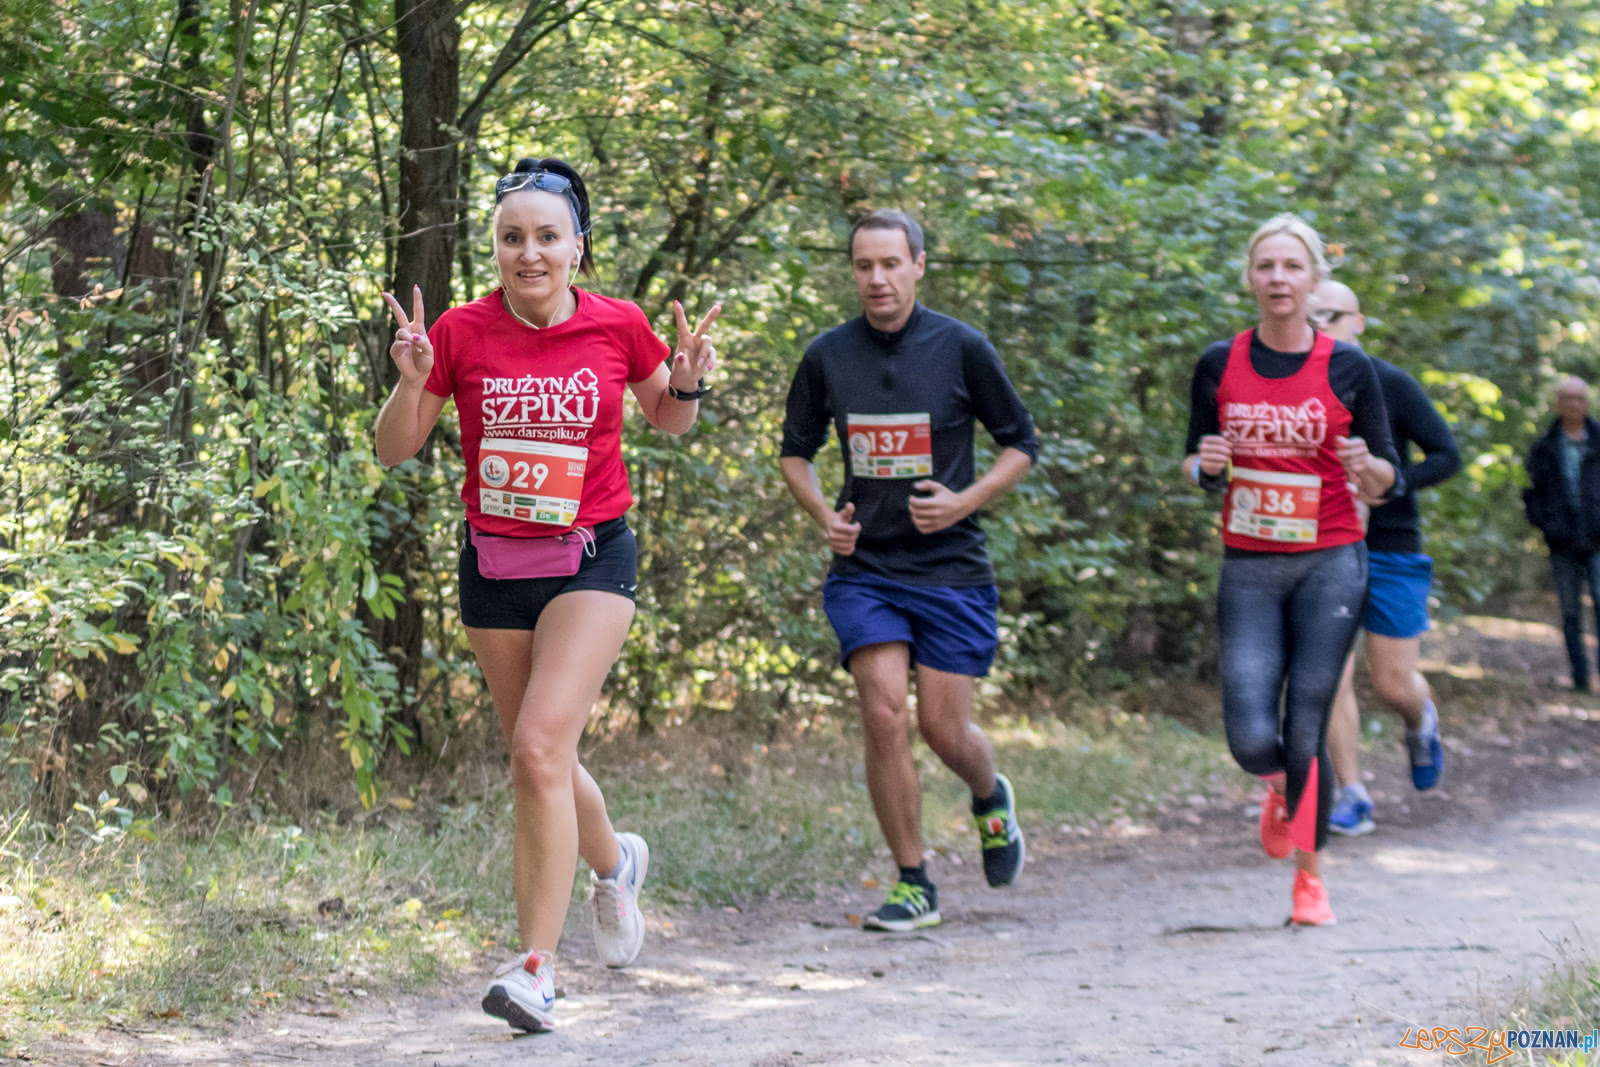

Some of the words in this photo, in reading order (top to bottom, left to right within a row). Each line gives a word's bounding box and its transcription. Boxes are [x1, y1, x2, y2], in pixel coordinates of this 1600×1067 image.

[482, 374, 579, 395] DRUŻYNA
[482, 394, 600, 425] SZPIKU
[867, 431, 909, 453] 137
[1223, 420, 1328, 445] SZPIKU
[512, 461, 549, 490] 29
[1253, 487, 1296, 514] 136
